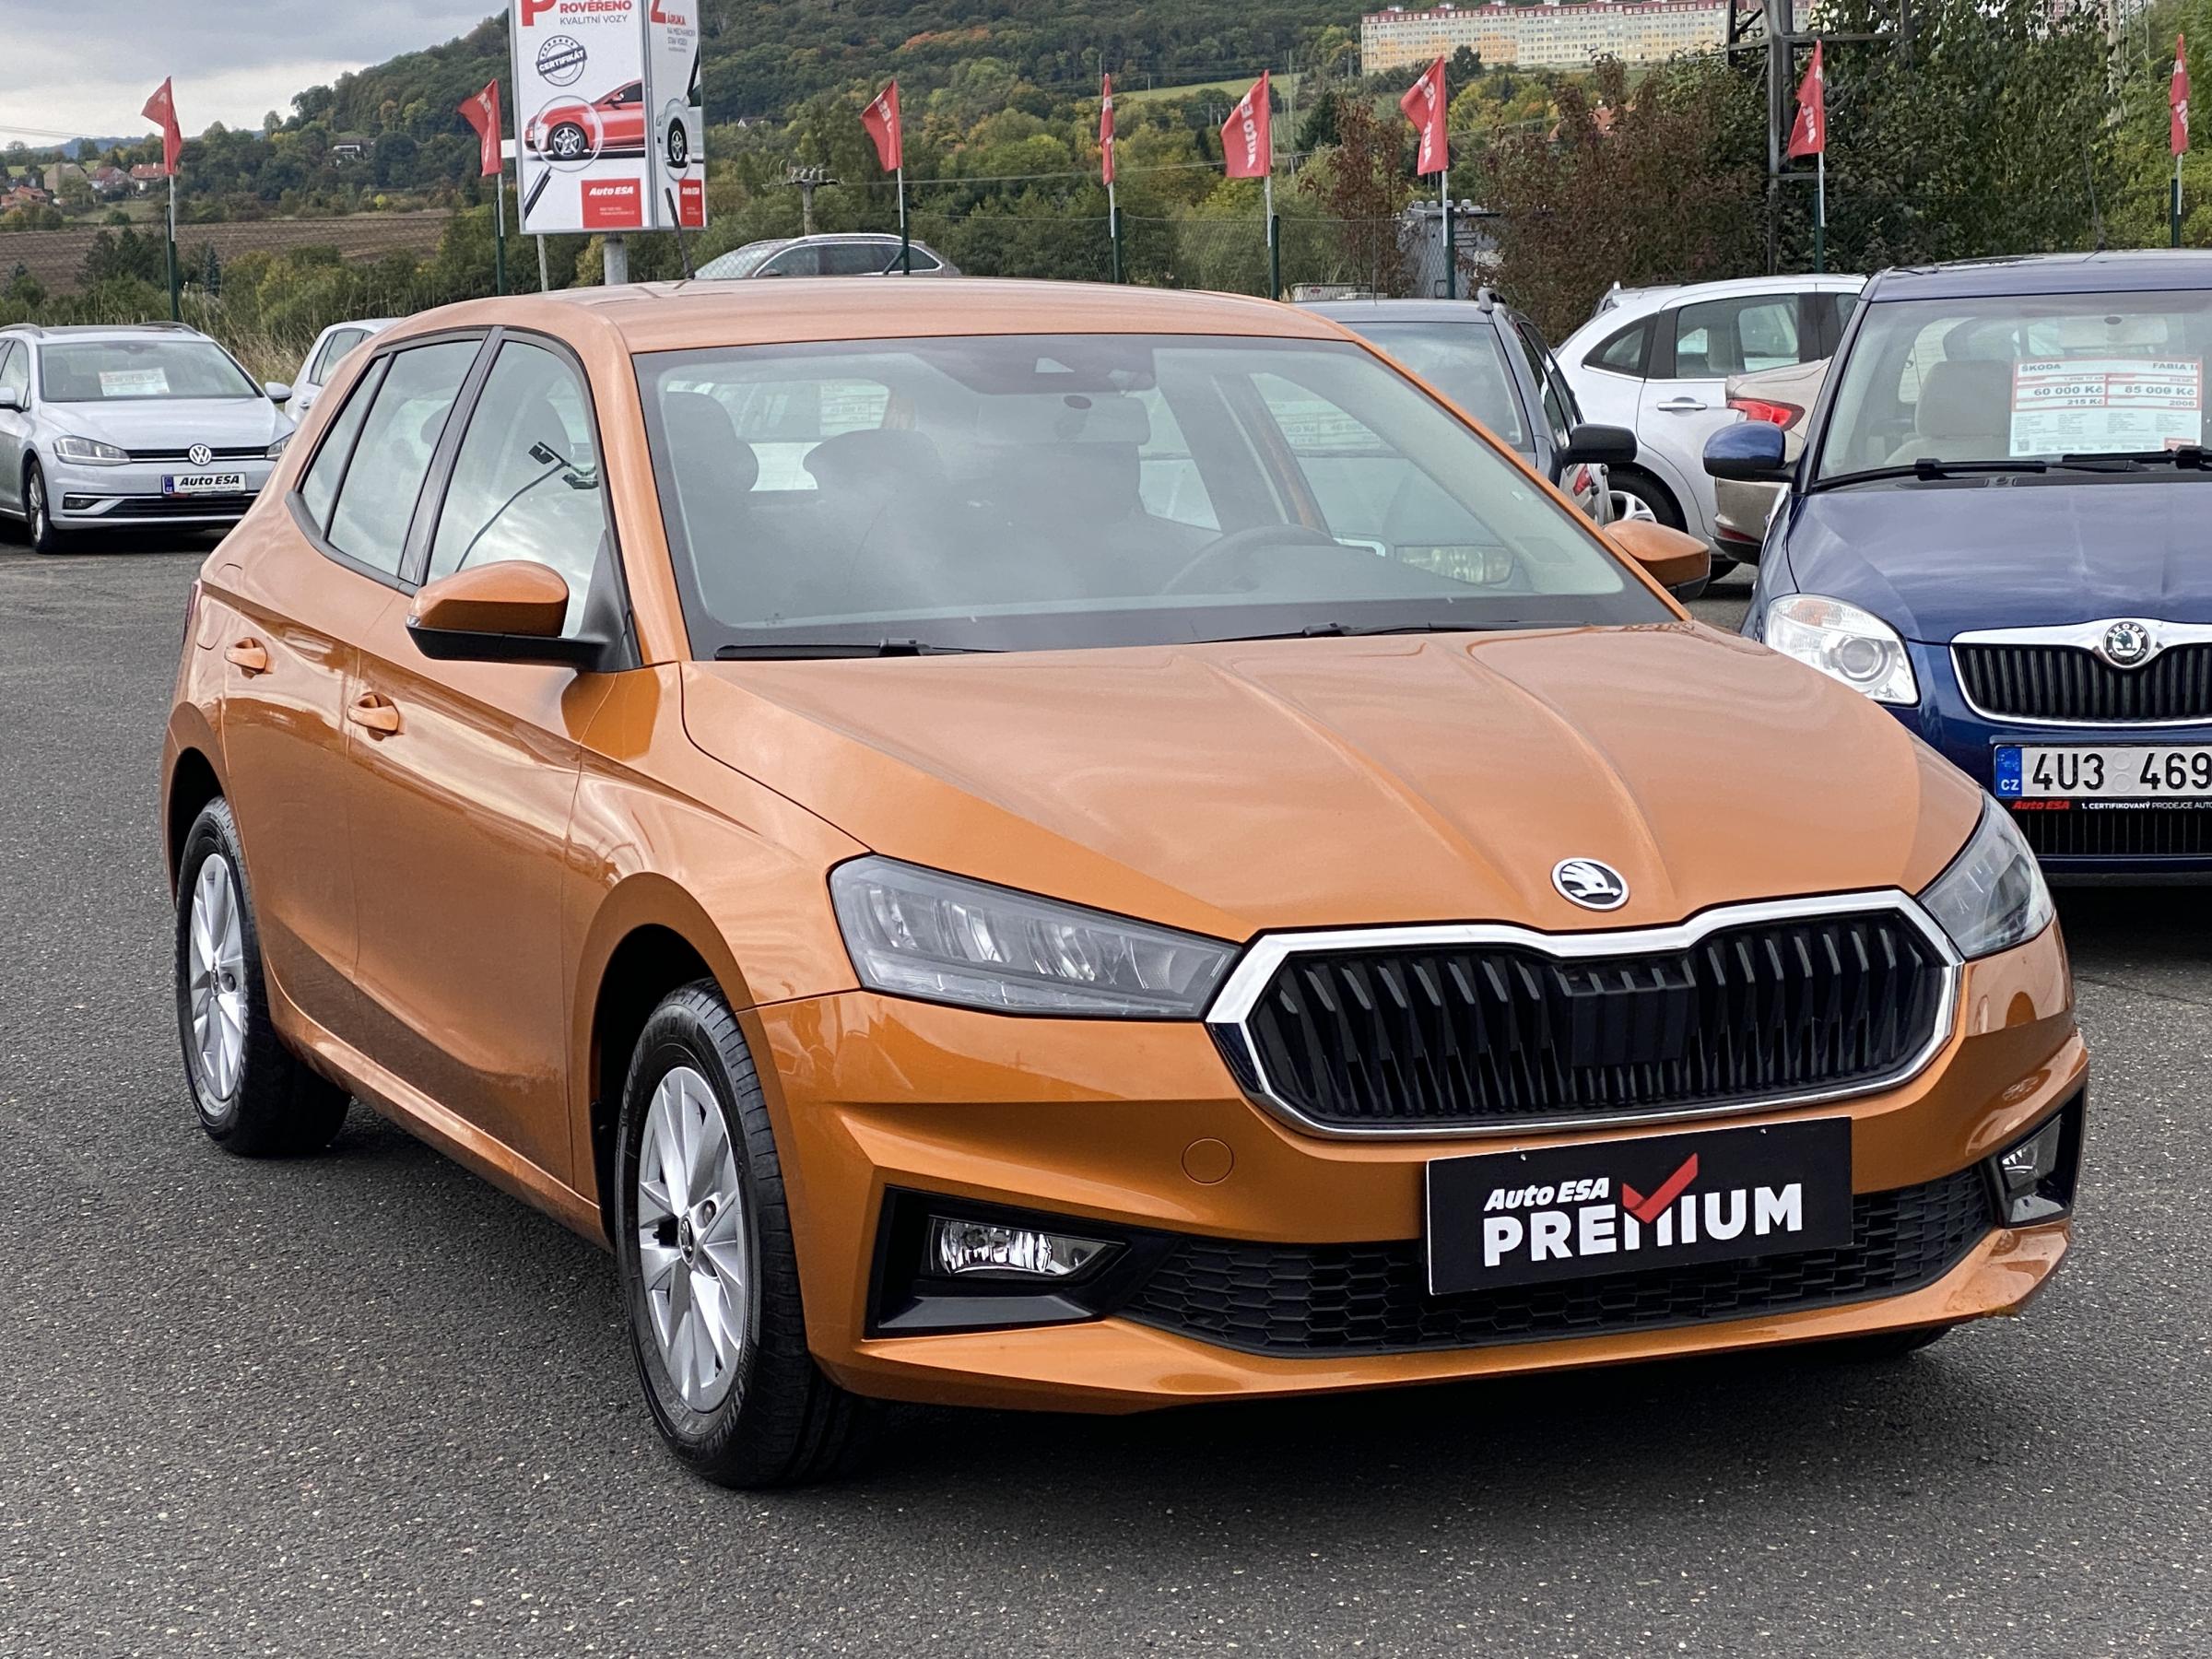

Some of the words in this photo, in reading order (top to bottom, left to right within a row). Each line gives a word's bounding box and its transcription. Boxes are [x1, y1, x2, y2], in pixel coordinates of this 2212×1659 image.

[559, 15, 601, 26] KVALITNÍ
[603, 14, 628, 24] VOZY
[538, 49, 585, 72] CERTIFIKÁT
[589, 186, 615, 196] Auto
[615, 185, 634, 195] ESA
[2152, 362, 2187, 371] FABIA
[2033, 387, 2051, 396] 60
[2054, 386, 2080, 395] 000
[2085, 385, 2103, 394] Kč
[2146, 386, 2171, 395] 000
[2176, 387, 2195, 396] Kč
[179, 477, 213, 487] Auto
[214, 475, 240, 485] ESA
[2032, 752, 2105, 791] 4U3
[2139, 752, 2212, 791] 469
[2000, 779, 2019, 791] CZ
[2011, 800, 2044, 810] Auto
[2045, 800, 2070, 810] ESA
[2088, 801, 2151, 810] CERTIFIKOVANÝ
[2151, 802, 2193, 810] PRODEJCE
[1483, 1183, 1556, 1212] Auto
[1556, 1177, 1610, 1204] ESA
[1483, 1182, 1803, 1267] PREMIUM
